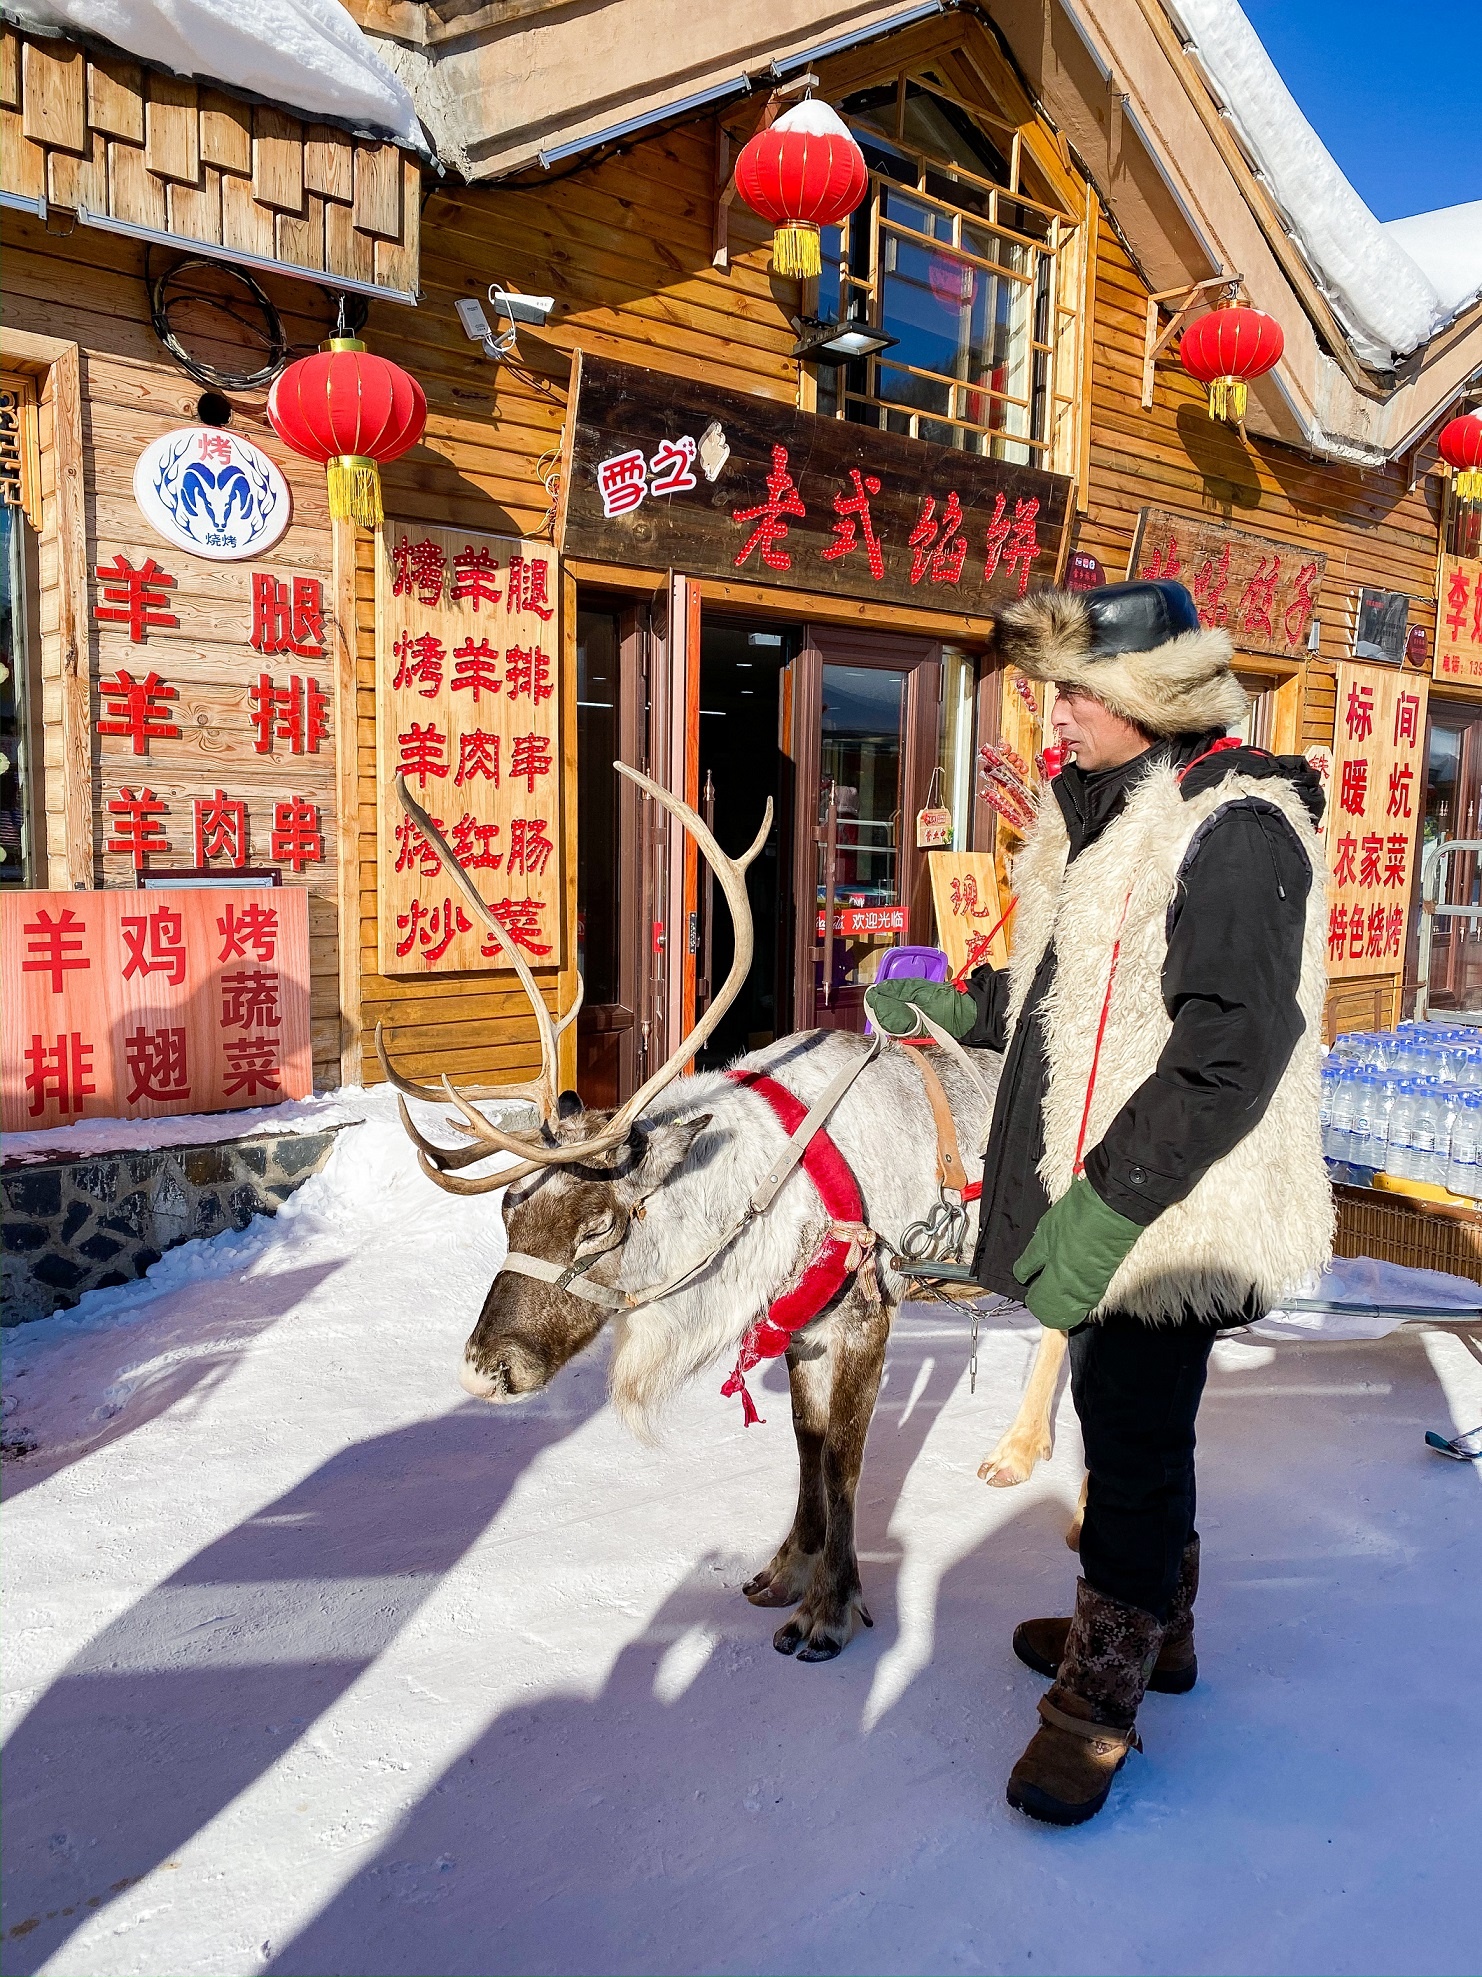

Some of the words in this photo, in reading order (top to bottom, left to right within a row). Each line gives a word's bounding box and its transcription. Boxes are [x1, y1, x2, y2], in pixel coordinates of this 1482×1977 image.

[198, 432, 232, 466] 烤
[600, 442, 694, 515] 雪之
[205, 532, 238, 549] 烧烤
[732, 442, 1042, 597] 老式馅饼
[93, 553, 326, 657] 羊腿
[392, 535, 555, 622] 烤羊腿
[392, 629, 555, 706] 烤羊排
[96, 668, 328, 755] 羊排
[1345, 681, 1420, 749] 标间
[395, 722, 554, 794] 羊肉串
[1339, 758, 1414, 819] 暖炕
[105, 785, 323, 872] 羊肉串
[394, 812, 554, 877] 烤红肠
[1332, 831, 1409, 890] 农家菜
[396, 896, 553, 961] 炒菜
[851, 910, 904, 930] 欢迎光临
[1327, 902, 1404, 962] 特色烧烤
[22, 908, 97, 1118] 羊排
[120, 905, 192, 1106] 鸡翅
[216, 903, 283, 1097] 烤蔬菜
